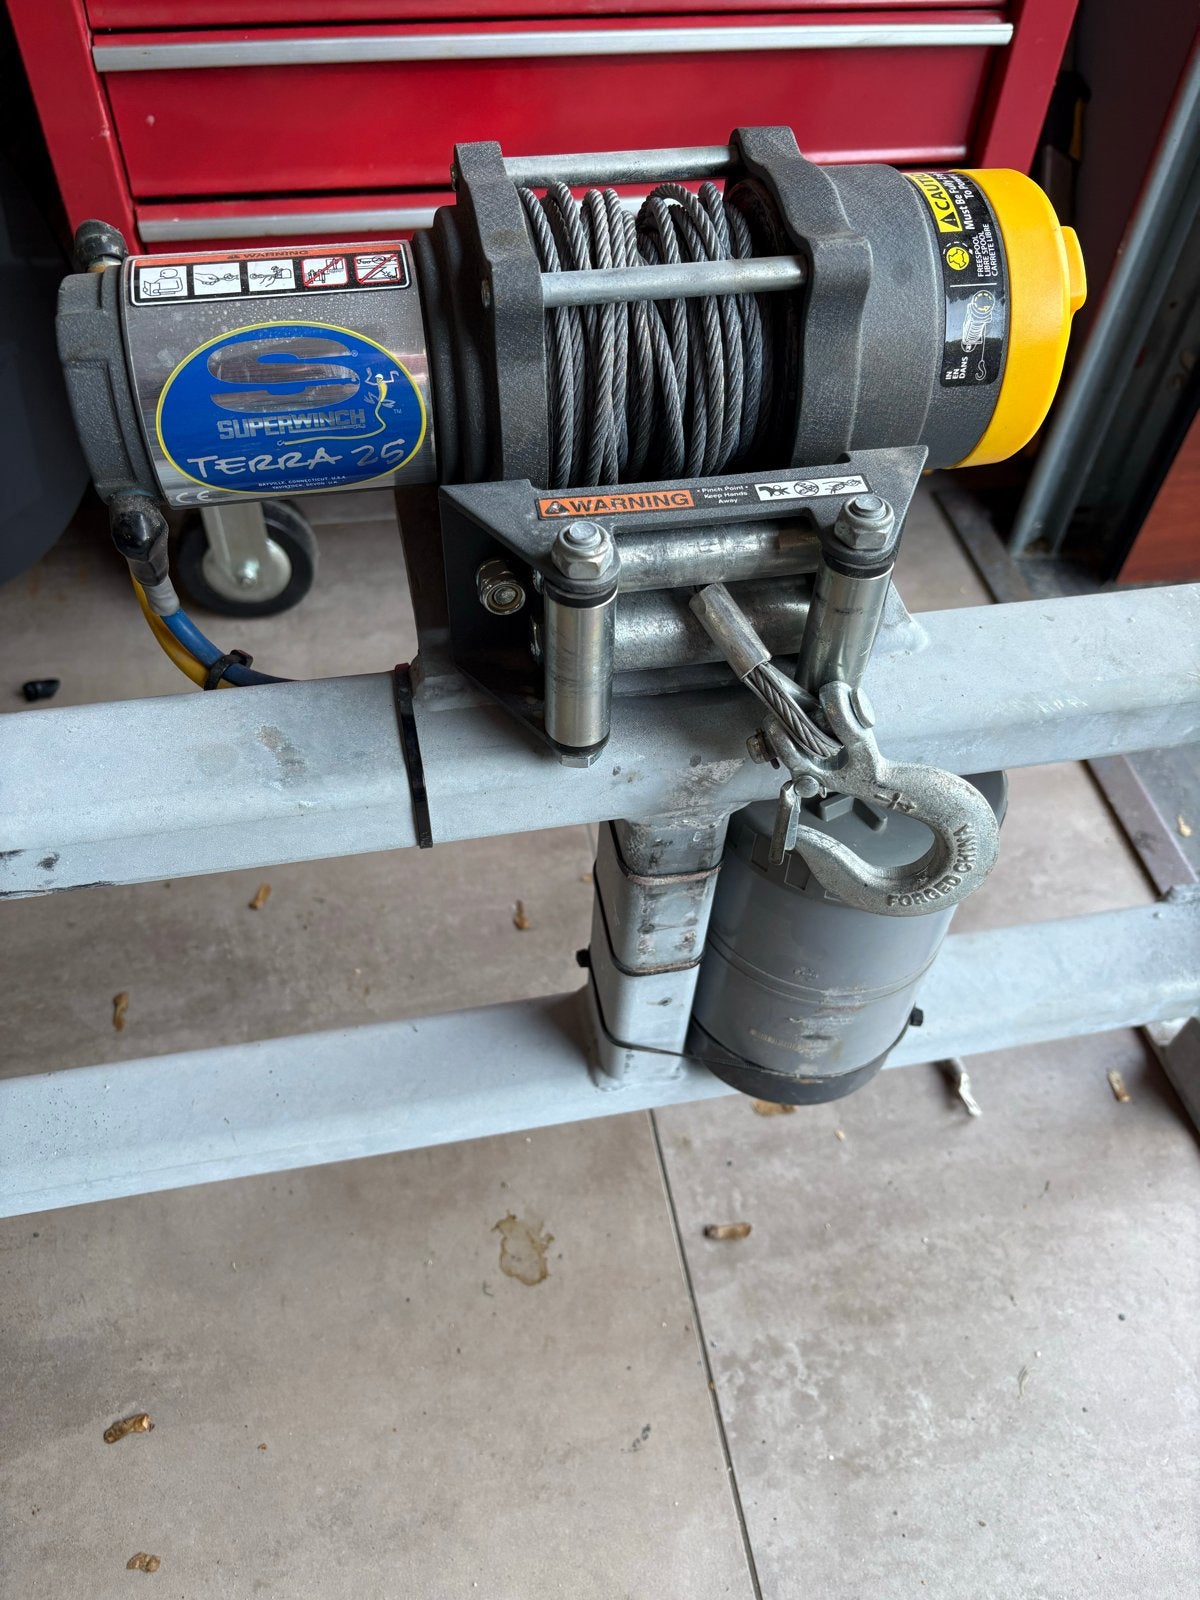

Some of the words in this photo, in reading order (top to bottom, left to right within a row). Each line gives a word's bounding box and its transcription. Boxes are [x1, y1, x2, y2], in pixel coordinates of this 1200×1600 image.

[954, 194, 966, 205] Be
[963, 189, 975, 200] To
[959, 206, 976, 230] Must
[977, 230, 989, 255] SPOOL
[982, 223, 993, 242] LIBRE
[243, 250, 309, 259] WARNING
[971, 234, 984, 277] FREESPOOL
[987, 242, 999, 277] CARRETE
[982, 255, 991, 277] LIBRE
[945, 370, 953, 380] IN
[951, 368, 960, 380] EN
[958, 356, 969, 379] DANS
[216, 409, 366, 440] SUPERWINCH
[187, 447, 344, 478] TERRA
[351, 439, 406, 467] 25
[175, 490, 212, 504] CE
[569, 492, 690, 513] WARNING
[886, 875, 962, 908] FORGED
[952, 822, 977, 874] CHINA
